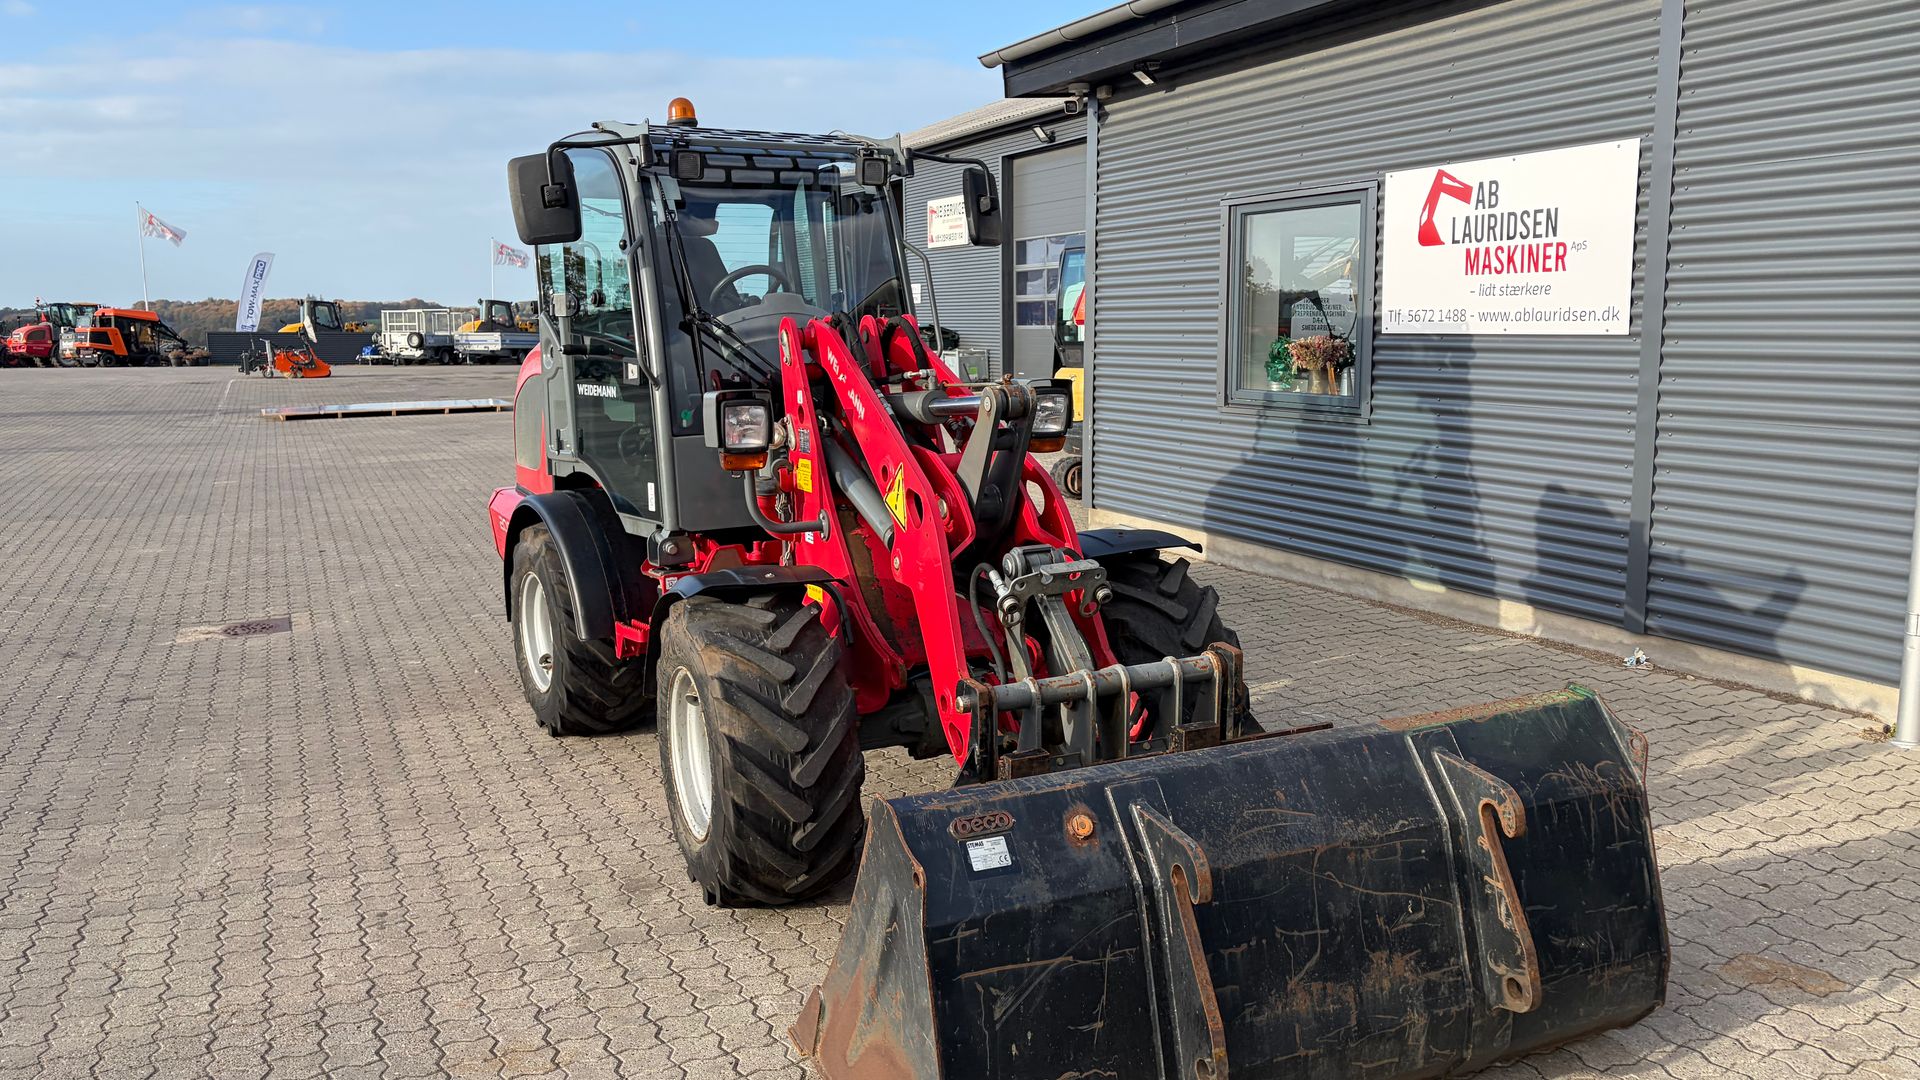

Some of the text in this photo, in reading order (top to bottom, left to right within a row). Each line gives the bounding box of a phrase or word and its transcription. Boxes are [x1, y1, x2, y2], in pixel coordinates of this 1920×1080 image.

[1474, 180, 1500, 210] AB
[1451, 207, 1559, 245] LAURIDSEN
[1464, 240, 1588, 276] MASKINER ApS
[254, 260, 266, 280] PRO
[1478, 283, 1496, 297] lidt
[1498, 282, 1552, 297] stærkere
[1388, 309, 1404, 325] Tlf.
[1407, 309, 1435, 323] 5672
[1438, 308, 1467, 323] 1488
[1478, 306, 1621, 323] www.ablauridsen.dk
[576, 383, 617, 398] WEIDEMANN
